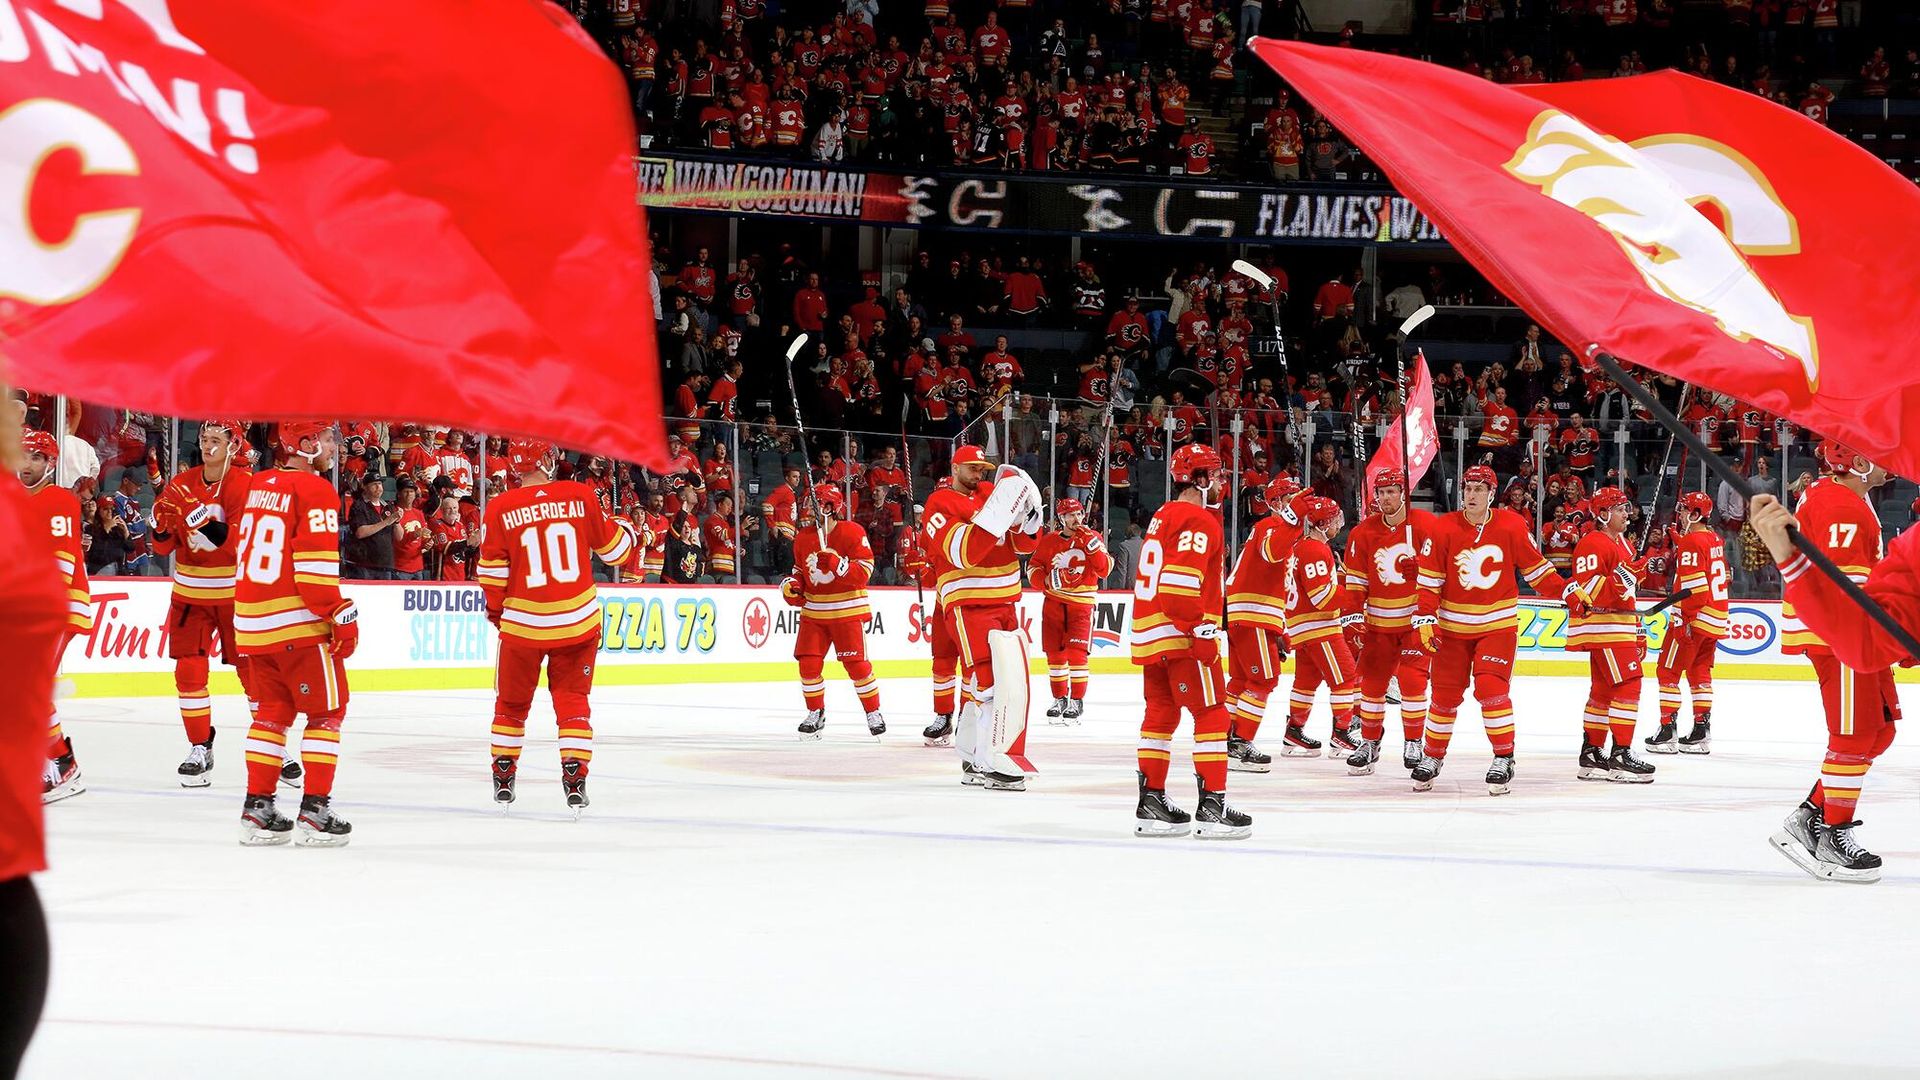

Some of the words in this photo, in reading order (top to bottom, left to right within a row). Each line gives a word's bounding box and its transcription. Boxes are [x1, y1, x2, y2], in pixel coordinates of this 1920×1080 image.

[674, 160, 736, 208] WIN
[741, 165, 866, 217] COLUMN!
[1256, 194, 1381, 239] FLAMES
[1391, 197, 1447, 241] WI
[50, 515, 73, 538] 91
[308, 508, 339, 533] 28
[502, 501, 585, 530] HUBERDEAU
[236, 512, 285, 585] 28
[1177, 530, 1209, 554] 29
[1828, 523, 1858, 548] 17
[520, 521, 581, 589] 10
[1134, 538, 1163, 601] 9
[1304, 560, 1328, 579] 88
[1576, 553, 1598, 574] 20
[1681, 551, 1698, 567] 21
[1711, 560, 1729, 601] 2
[403, 589, 442, 611] BUD
[445, 589, 486, 612] LIGH
[85, 592, 151, 659] Tim
[409, 613, 489, 661] SELTZER
[598, 597, 667, 653] ZZA
[675, 597, 717, 654] 73
[1481, 655, 1508, 665] CCM
